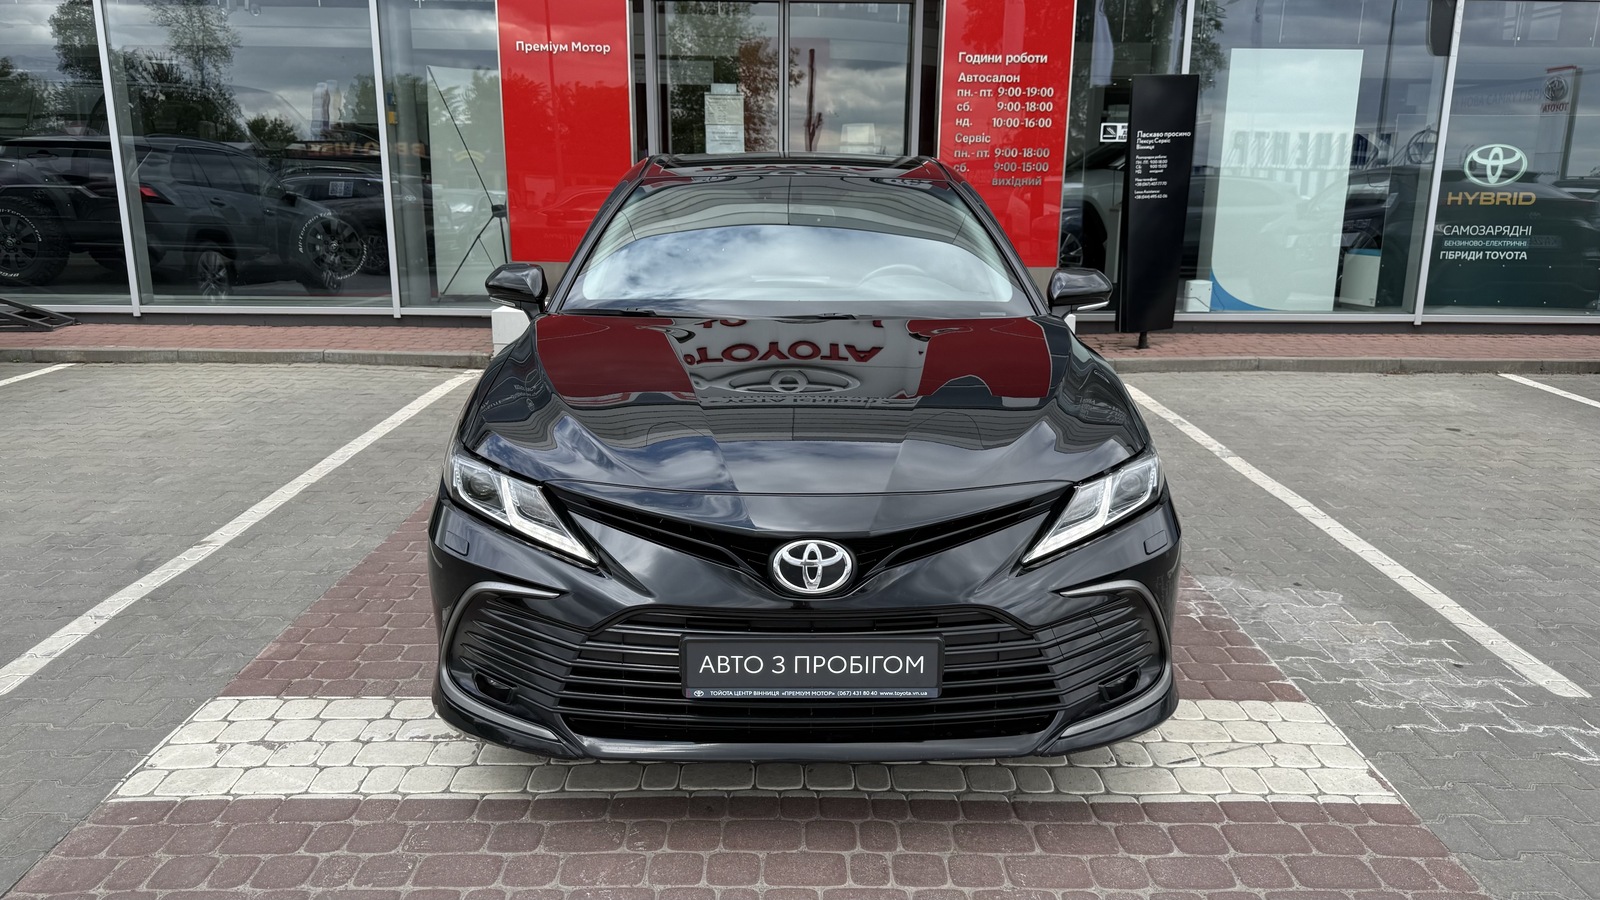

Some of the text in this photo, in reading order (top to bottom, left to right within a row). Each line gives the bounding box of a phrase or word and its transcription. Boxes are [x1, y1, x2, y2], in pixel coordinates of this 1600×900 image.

[515, 41, 611, 55] Преміум Мотор
[958, 52, 1048, 65] Години роботи
[957, 72, 1021, 83] Автосалон
[997, 87, 1055, 98] 9:00-19:00
[956, 101, 1054, 112] сб. 9:00-18:00
[955, 117, 1052, 128] нд. 10:00-16:00
[954, 132, 991, 144] Сервіс
[994, 148, 1050, 158] 9:00-18:00
[953, 161, 1049, 173] сб. 9:00-15:00
[991, 176, 1042, 187] вихідний
[1446, 191, 1537, 206] HYBRID
[1443, 225, 1533, 238] САМОЗАРЯДНІ
[1443, 239, 1528, 247] БЕНЗИНОВО-ЕЛЕКТРИЧНІ
[1440, 250, 1528, 261] ГІБРИДИ TOYOTA
[699, 655, 924, 674] АВТО З ПРОБІГОМ
